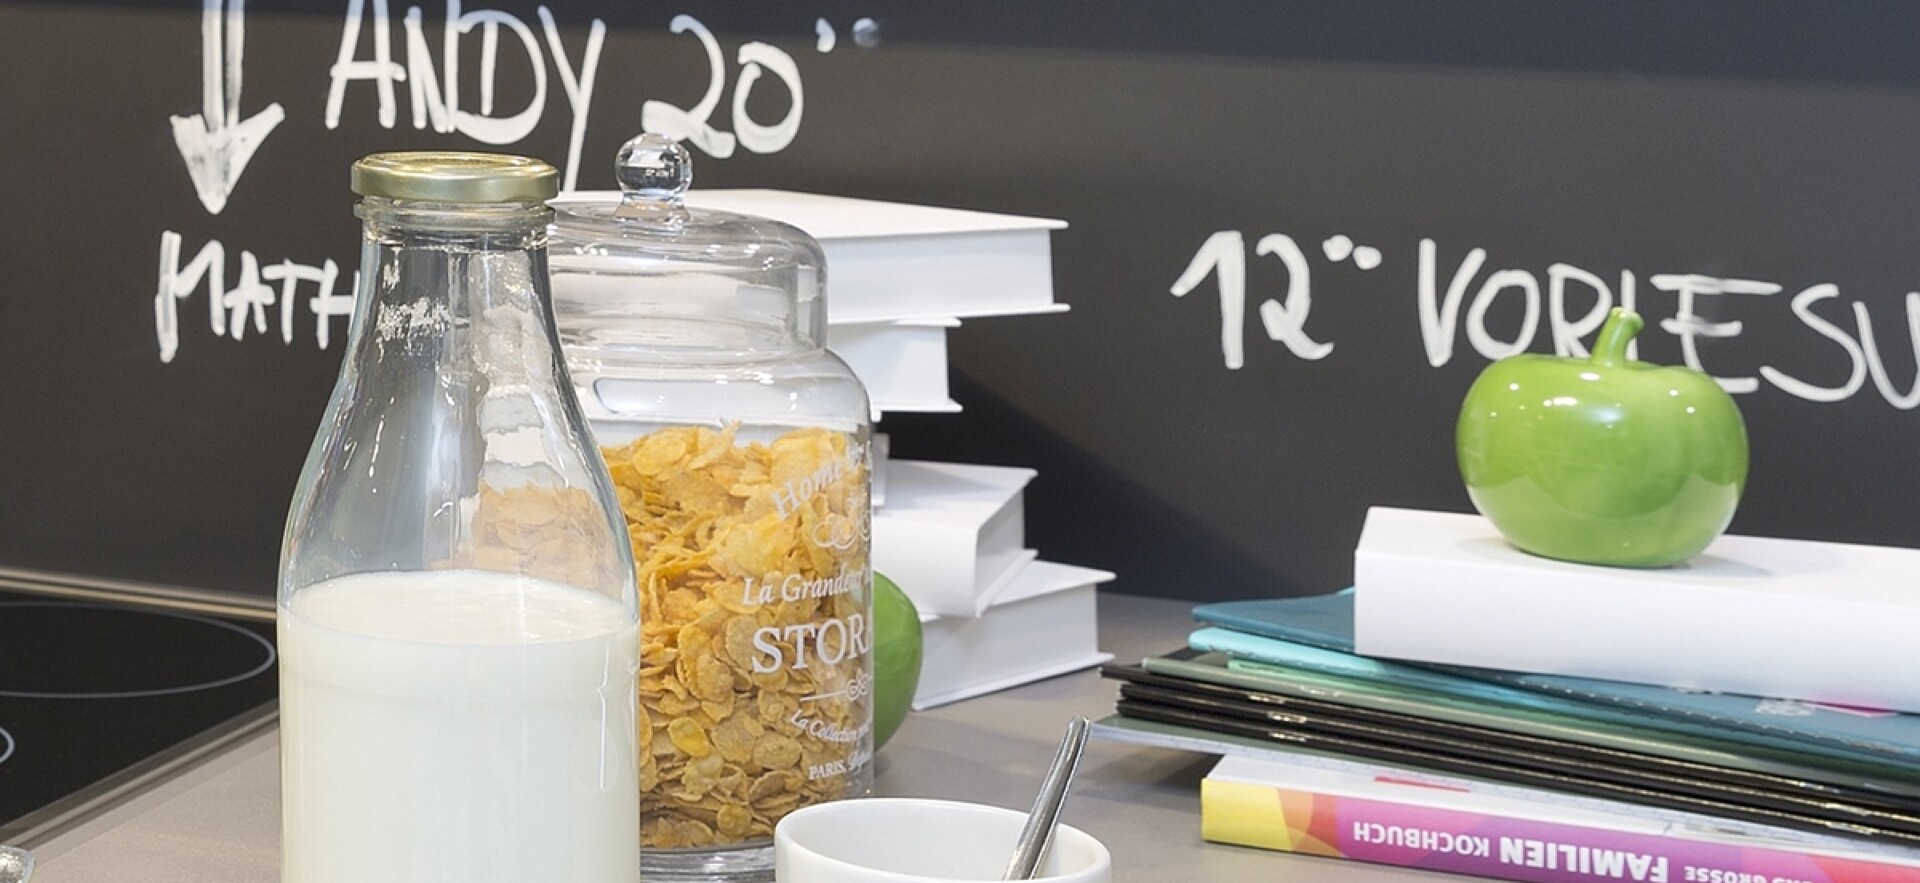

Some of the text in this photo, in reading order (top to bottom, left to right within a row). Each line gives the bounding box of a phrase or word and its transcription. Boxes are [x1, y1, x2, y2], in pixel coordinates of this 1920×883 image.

[325, 0, 606, 192] ANDY
[742, 577, 775, 606] La
[752, 612, 871, 674] STOR
[1353, 821, 1490, 858] KOCHBUCH
[1500, 836, 1669, 883] FAMILIEN
